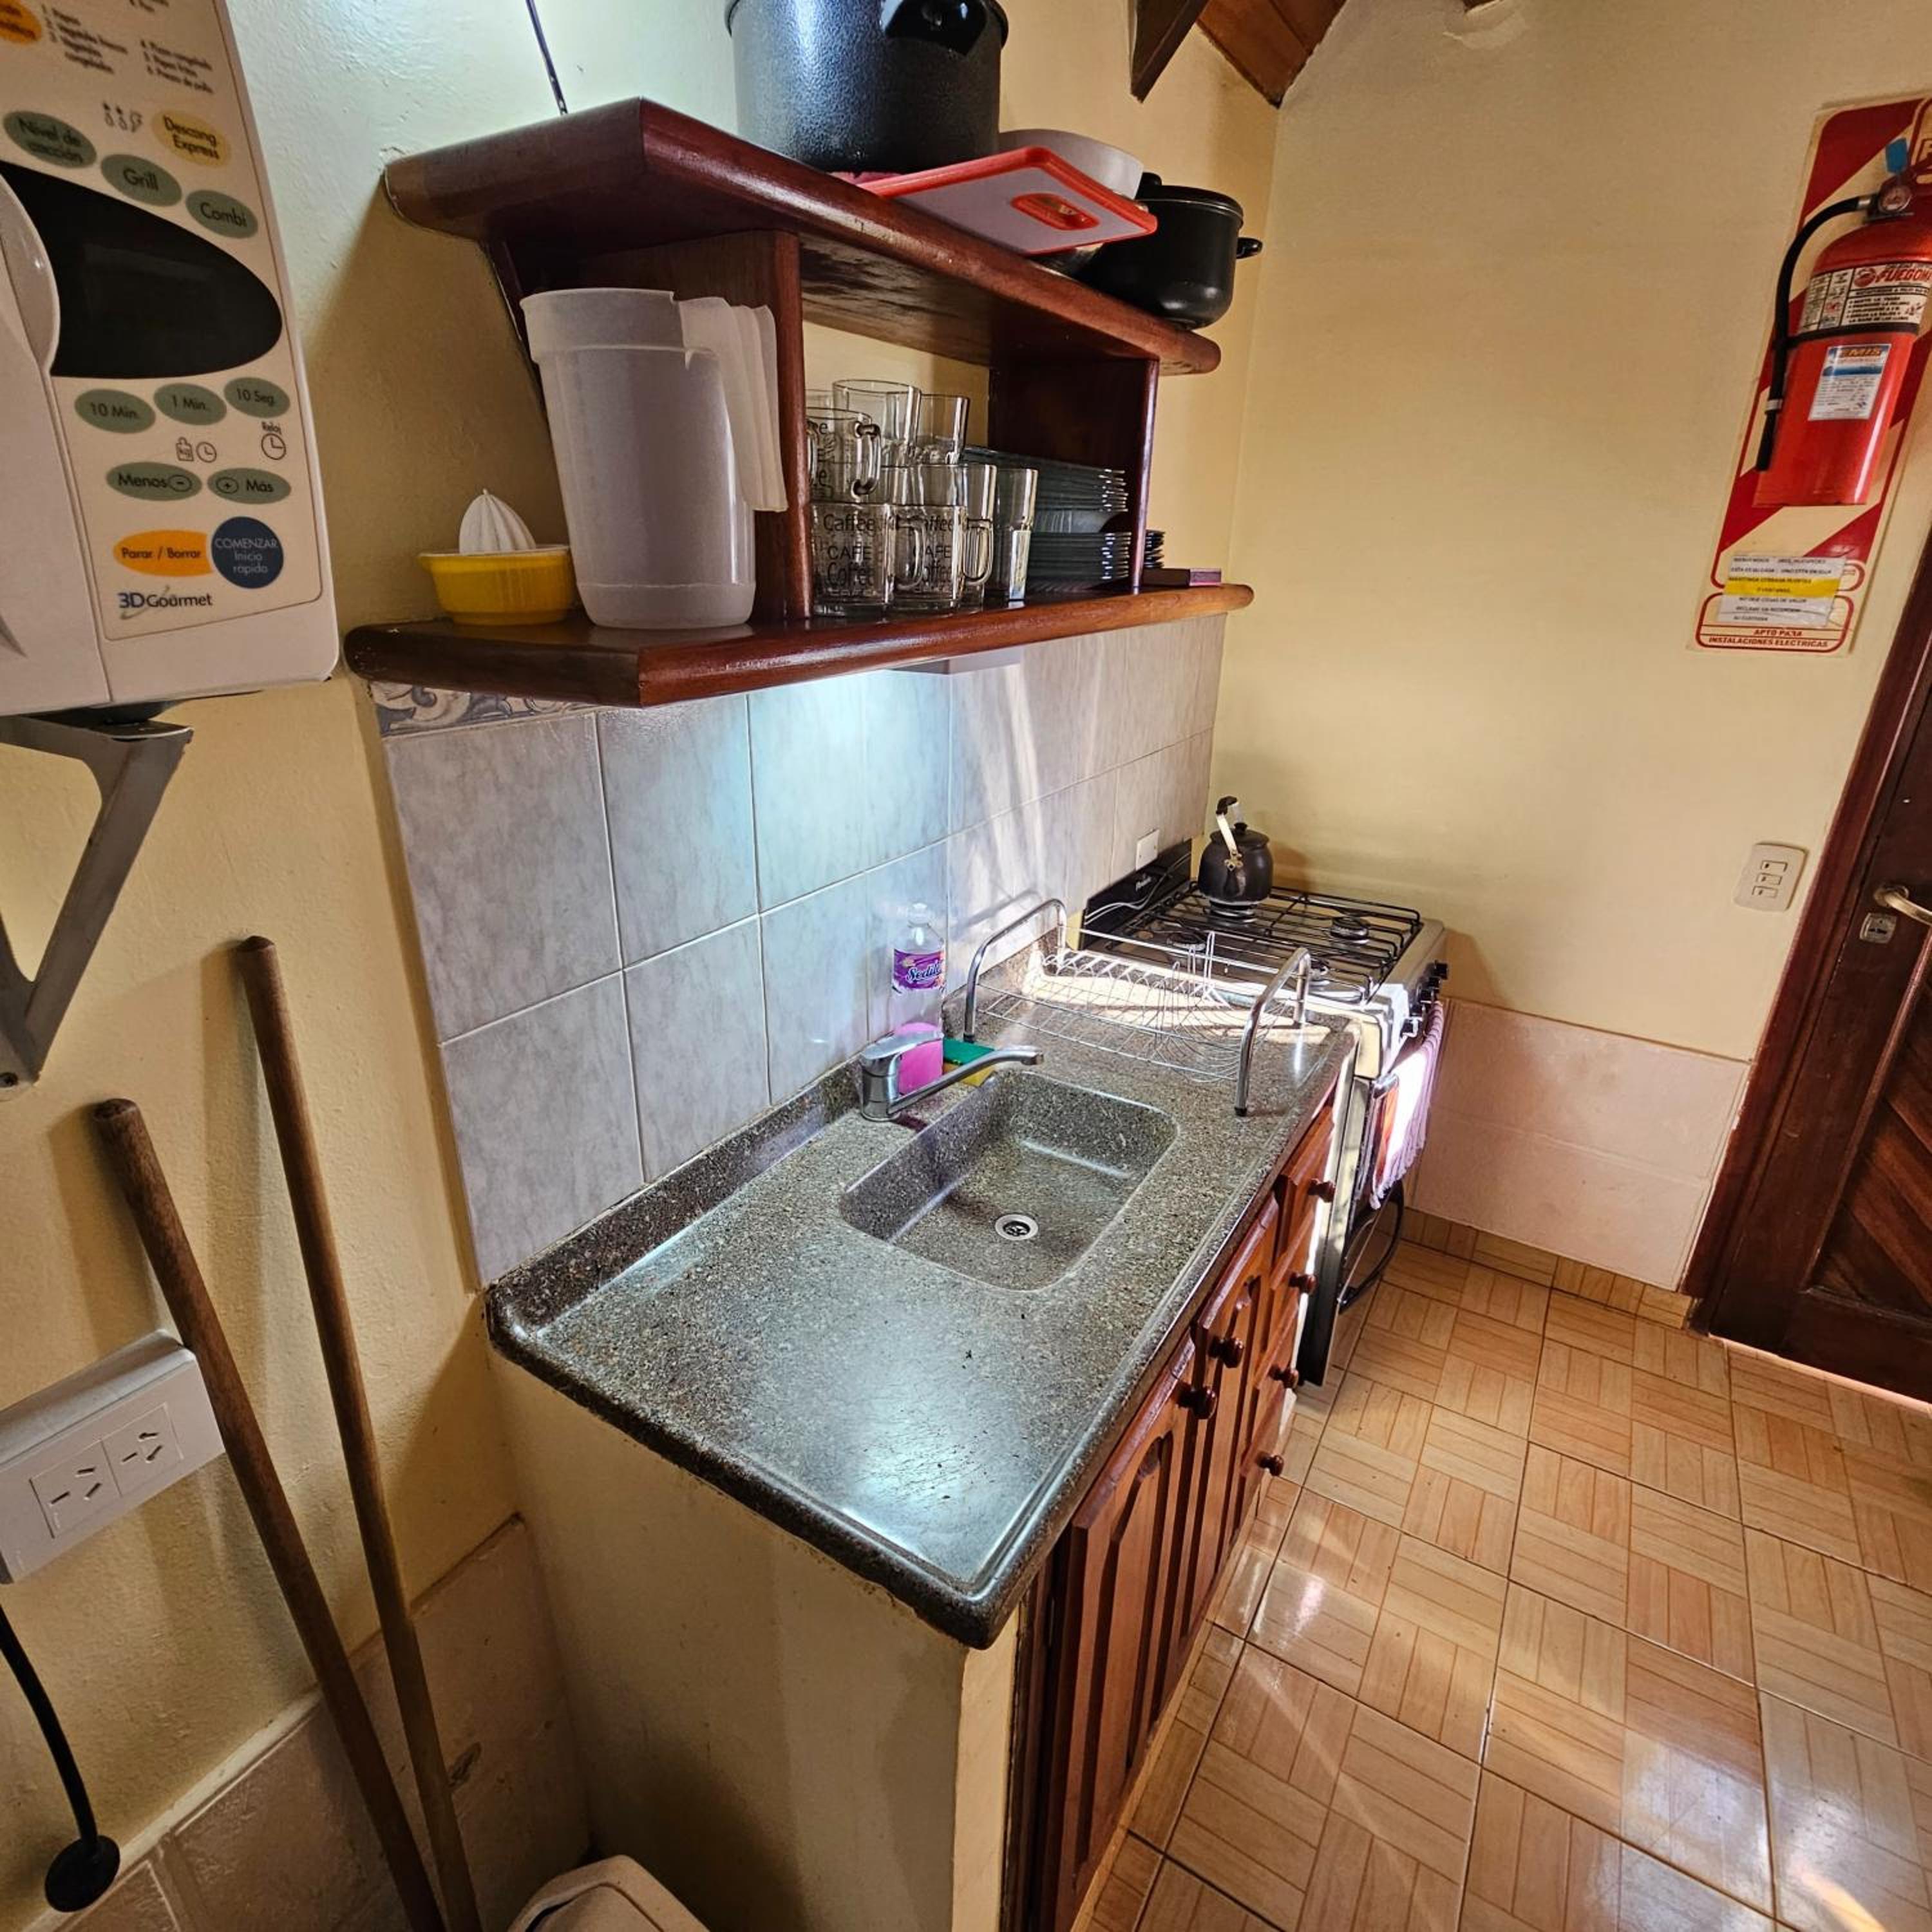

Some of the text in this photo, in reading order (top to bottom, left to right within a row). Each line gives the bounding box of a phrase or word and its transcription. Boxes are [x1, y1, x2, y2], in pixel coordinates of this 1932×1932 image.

[171, 133, 220, 160] Express
[122, 167, 159, 192] Grill
[200, 201, 248, 227] Combi
[172, 394, 178, 409] 1
[236, 387, 251, 402] 10
[90, 402, 108, 417] 10
[118, 473, 167, 488] Menos
[215, 537, 278, 549] COMENZAR
[122, 547, 153, 558] Parar
[167, 547, 202, 559] Borrar
[234, 550, 263, 562] Inicio
[1754, 629, 1777, 637] APTO
[1709, 637, 1828, 648] INSTALACIONES ELECTRICAS
